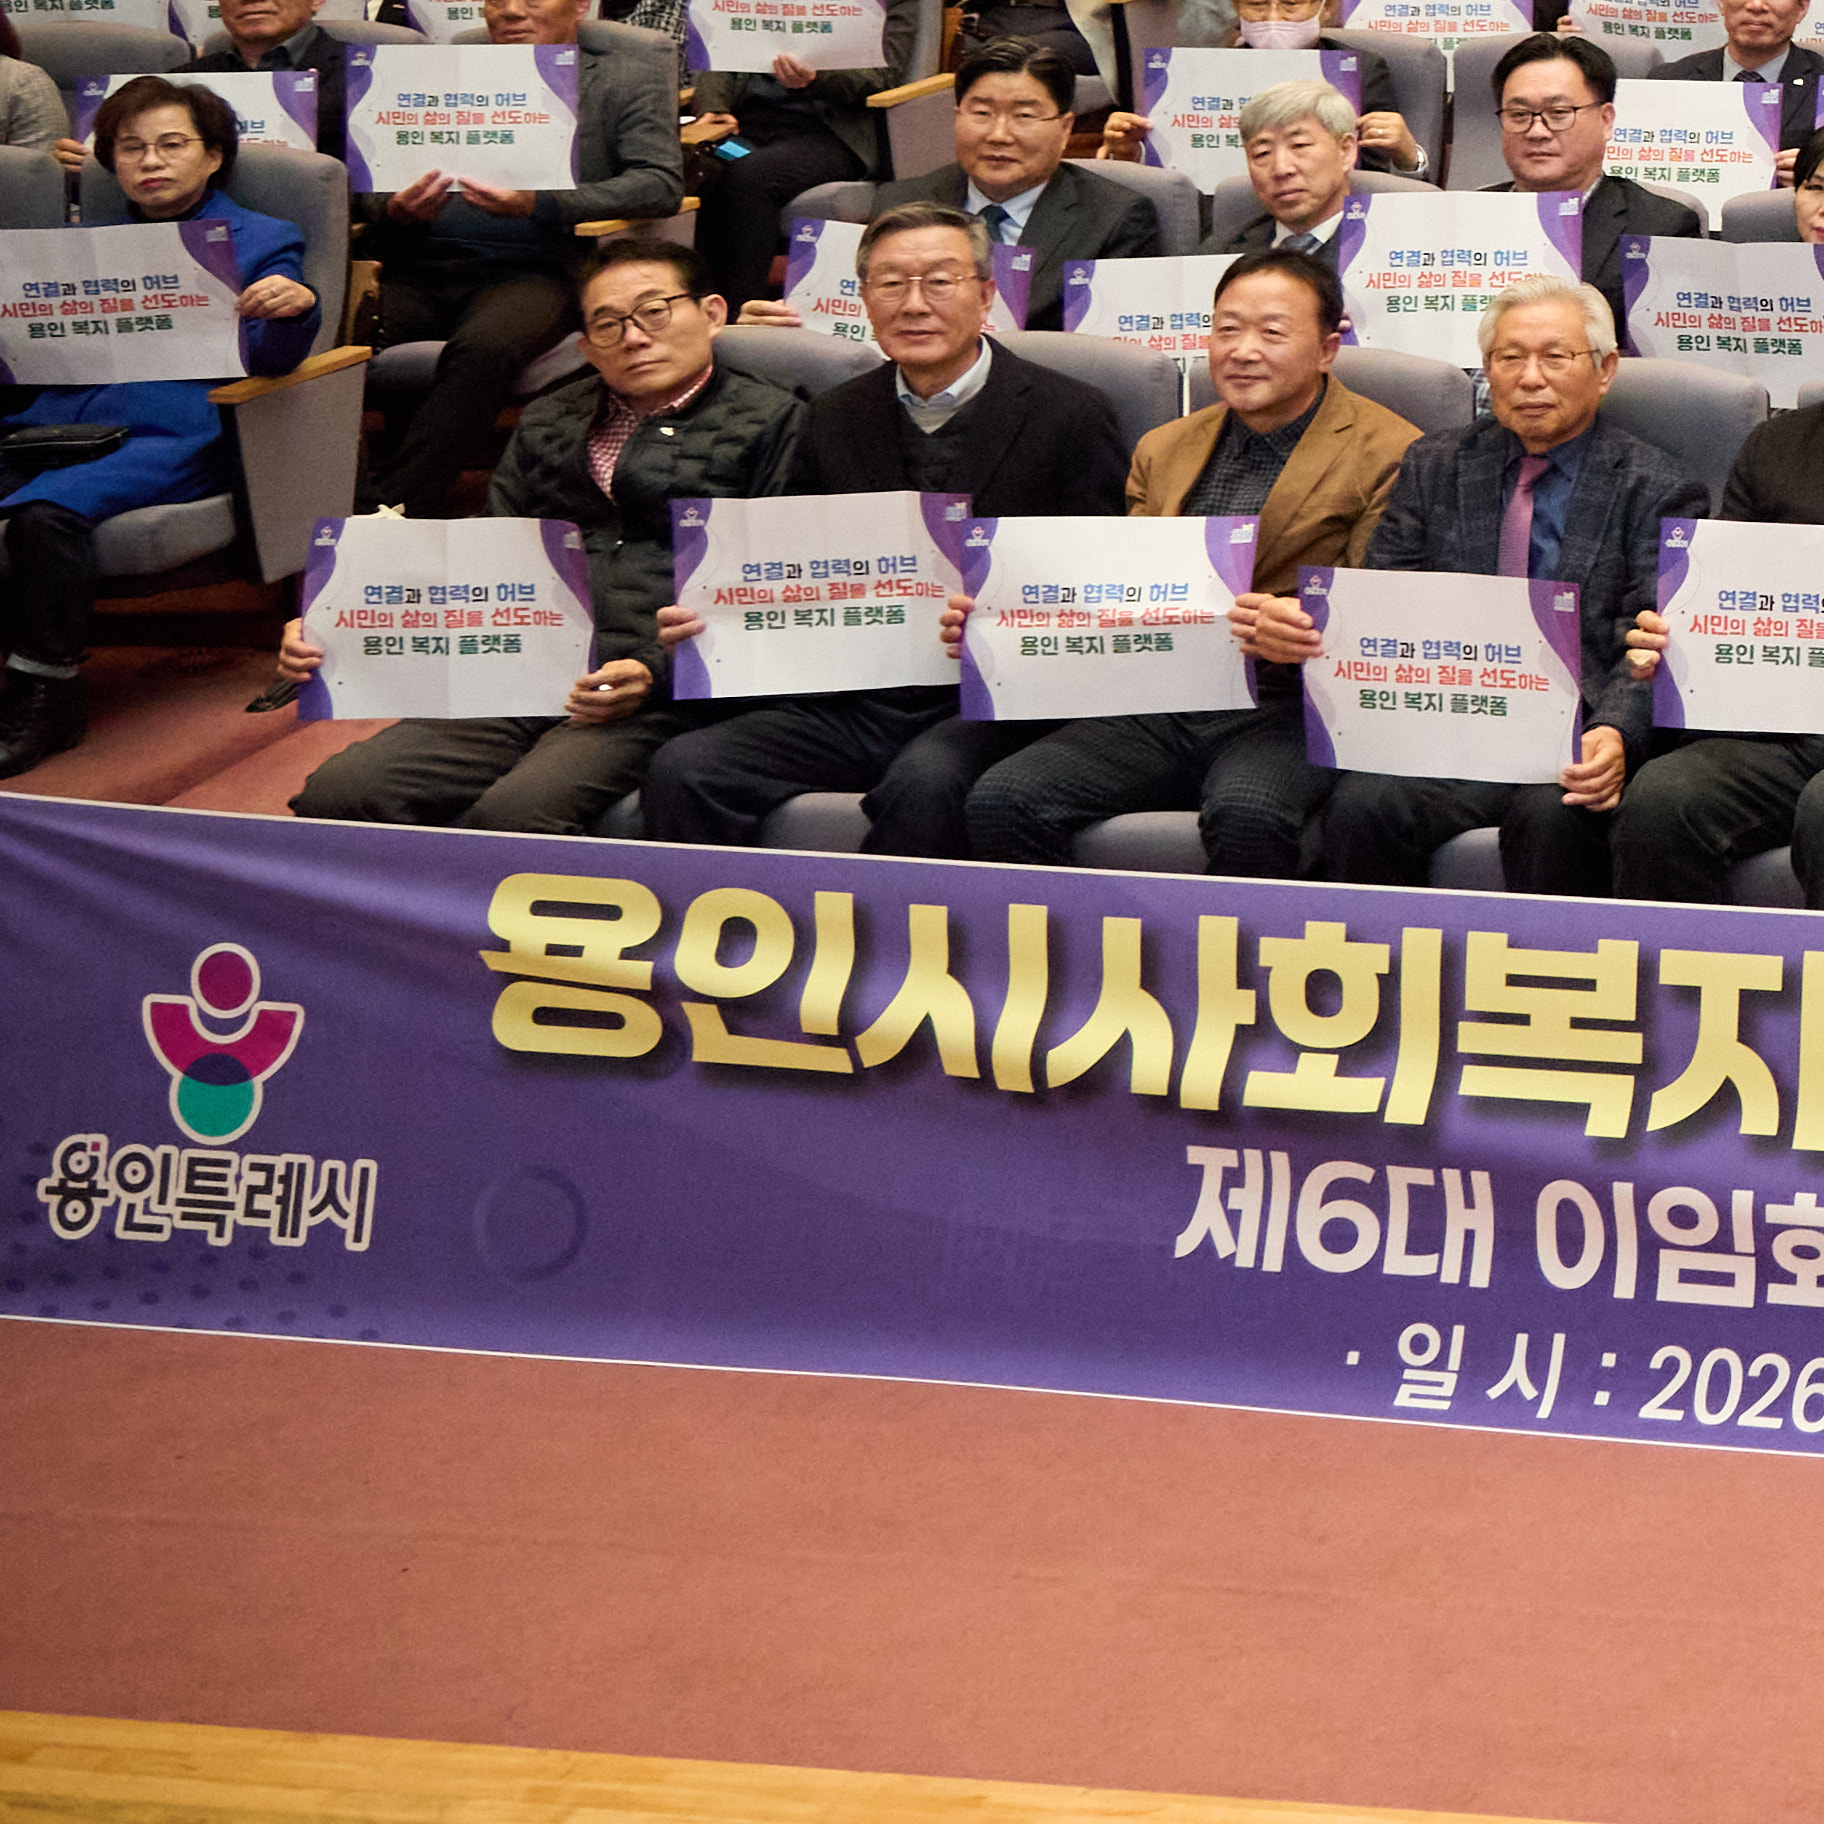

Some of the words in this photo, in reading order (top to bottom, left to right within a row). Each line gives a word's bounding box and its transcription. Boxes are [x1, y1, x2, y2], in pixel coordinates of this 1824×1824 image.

[396, 93, 439, 108] 연결과
[444, 92, 488, 107] 협력의
[494, 92, 526, 106] 허브
[375, 111, 417, 125] 시민의
[423, 111, 450, 124] 삶의
[456, 111, 484, 125] 질을
[490, 110, 550, 125] 선도하는
[395, 130, 424, 145] 용인
[430, 130, 460, 144] 복지
[466, 130, 514, 145] 플랫폼
[22, 280, 77, 299] 연결과
[81, 277, 136, 294] 협력의
[141, 274, 180, 290] 허브
[27, 322, 66, 339] 용인
[71, 319, 109, 335] 복지
[115, 315, 173, 333] 플랫폼
[364, 585, 422, 605] 연결과
[429, 584, 487, 603] 협력의
[495, 584, 536, 602] 허브
[335, 610, 393, 628] 시민의
[401, 609, 437, 628] 삶의
[445, 609, 482, 627] 질을
[490, 607, 567, 627] 선도하는
[363, 636, 403, 655] 용인
[411, 635, 451, 654] 복지
[460, 634, 521, 654] 플랫폼
[1360, 636, 1416, 660] 연결과
[1422, 639, 1477, 662] 협력의
[1483, 643, 1522, 664] 허브
[1332, 659, 1388, 682] 시민의
[1395, 664, 1430, 684] 삶의
[1437, 666, 1471, 687] 질을
[1479, 667, 1550, 692] 선도하는
[1358, 689, 1397, 711] 용인
[1404, 691, 1442, 712] 복지
[1450, 693, 1508, 716] 플랫폼
[42, 1139, 373, 1246] 용인특례시
[1175, 1147, 1493, 1287] 제6대
